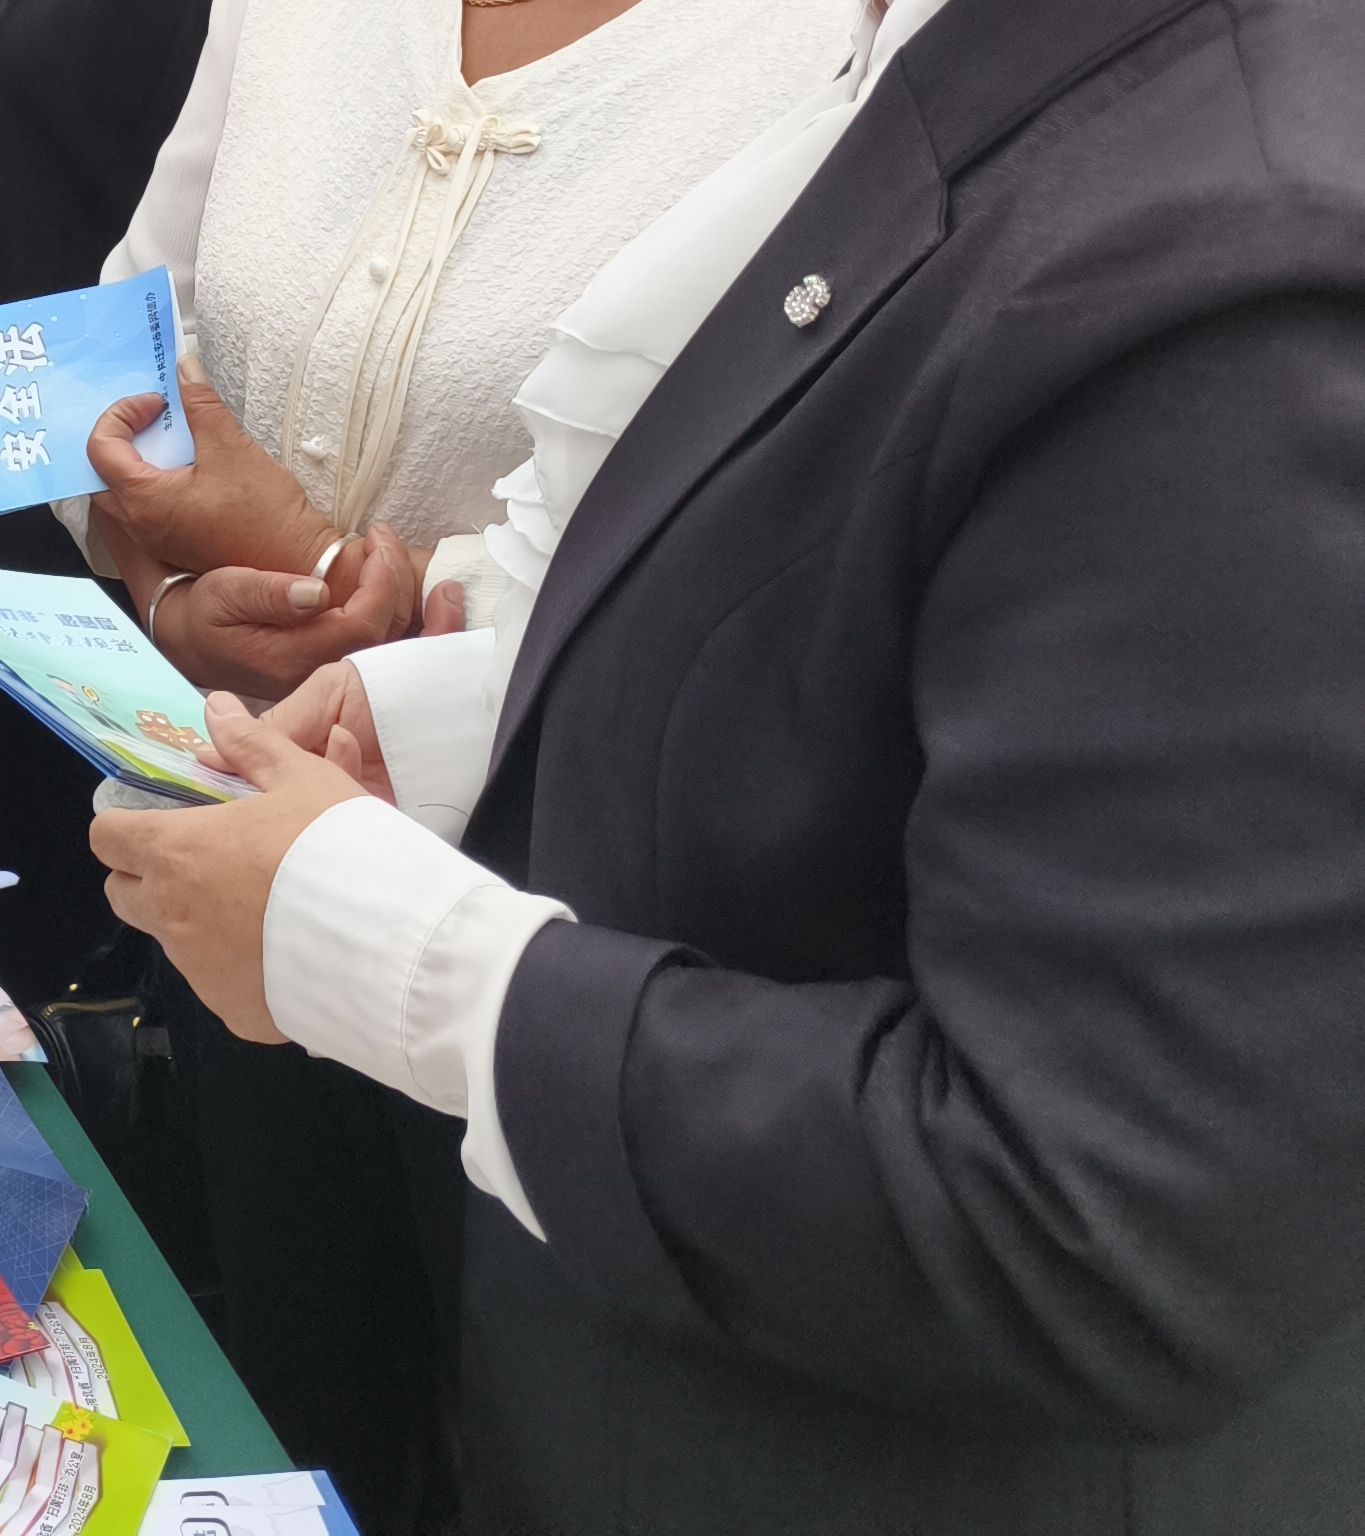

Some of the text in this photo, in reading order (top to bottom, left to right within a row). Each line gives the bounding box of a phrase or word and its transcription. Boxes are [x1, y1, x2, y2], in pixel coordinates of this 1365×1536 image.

[44, 1312, 99, 1406] 河北省“扫黄打非”办公室
[79, 1337, 109, 1380] 2024年8月
[69, 1484, 97, 1532] 2024年8月
